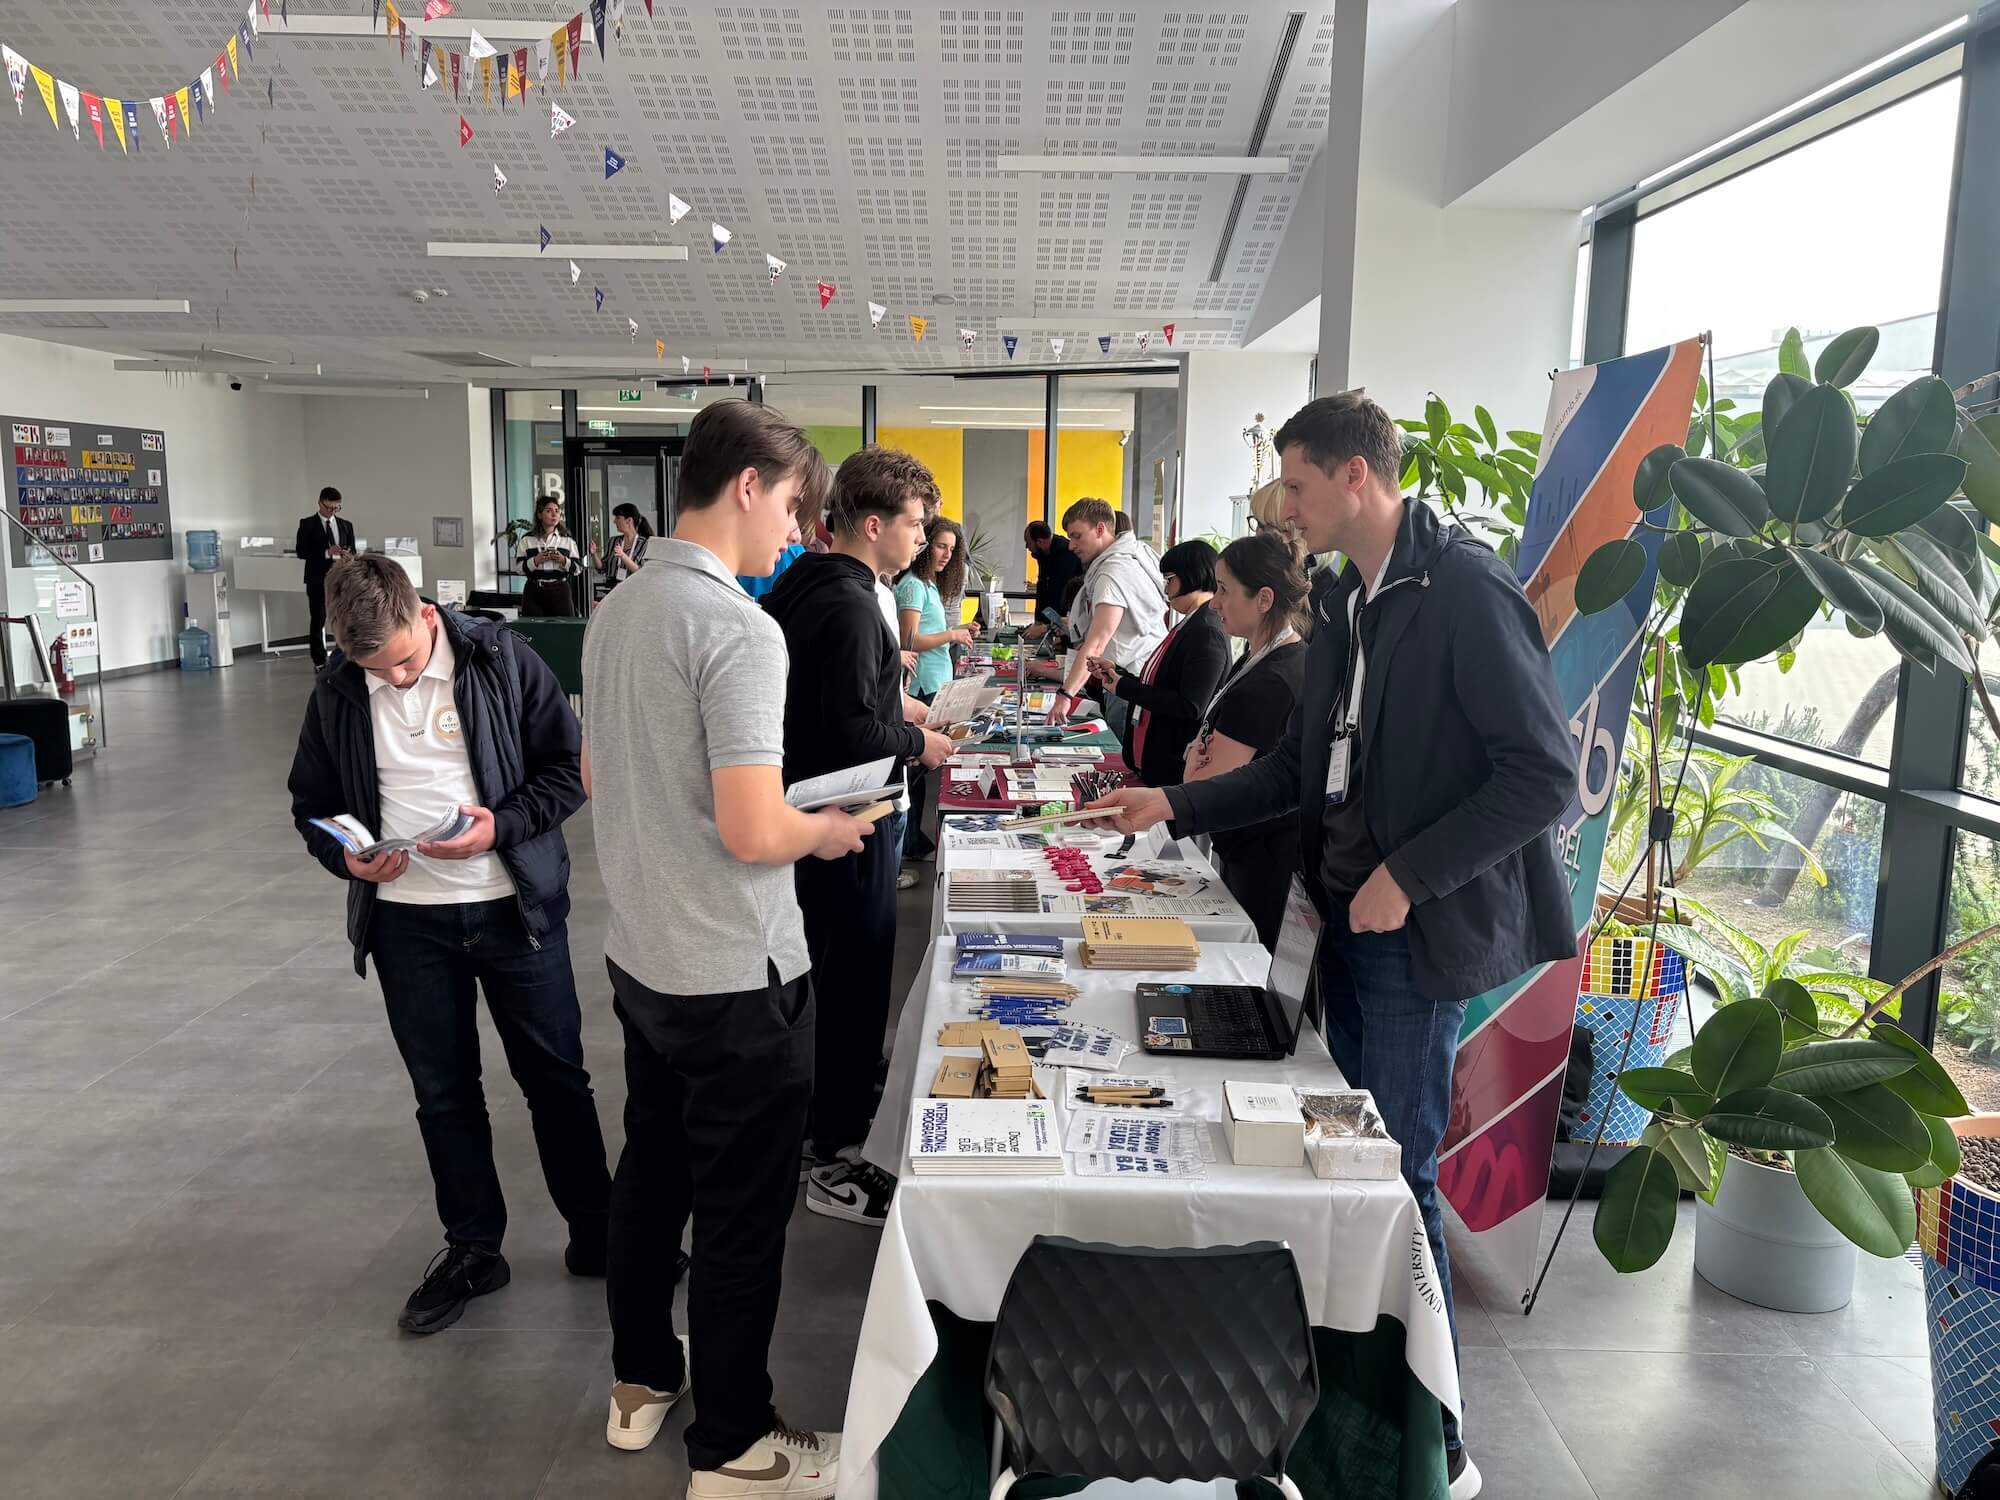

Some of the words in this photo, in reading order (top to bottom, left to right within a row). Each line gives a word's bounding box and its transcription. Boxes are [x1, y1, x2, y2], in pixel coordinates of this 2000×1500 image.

[920, 1108, 935, 1152] PROGRAMMES
[935, 1102, 948, 1152] INTERNATIONAL
[1107, 1125, 1128, 1150] EUBA
[1127, 1124, 1145, 1153] future
[1144, 1120, 1167, 1154] Discover
[1116, 1155, 1134, 1172] BA
[1411, 1227, 1443, 1314] UNIVERSITY
